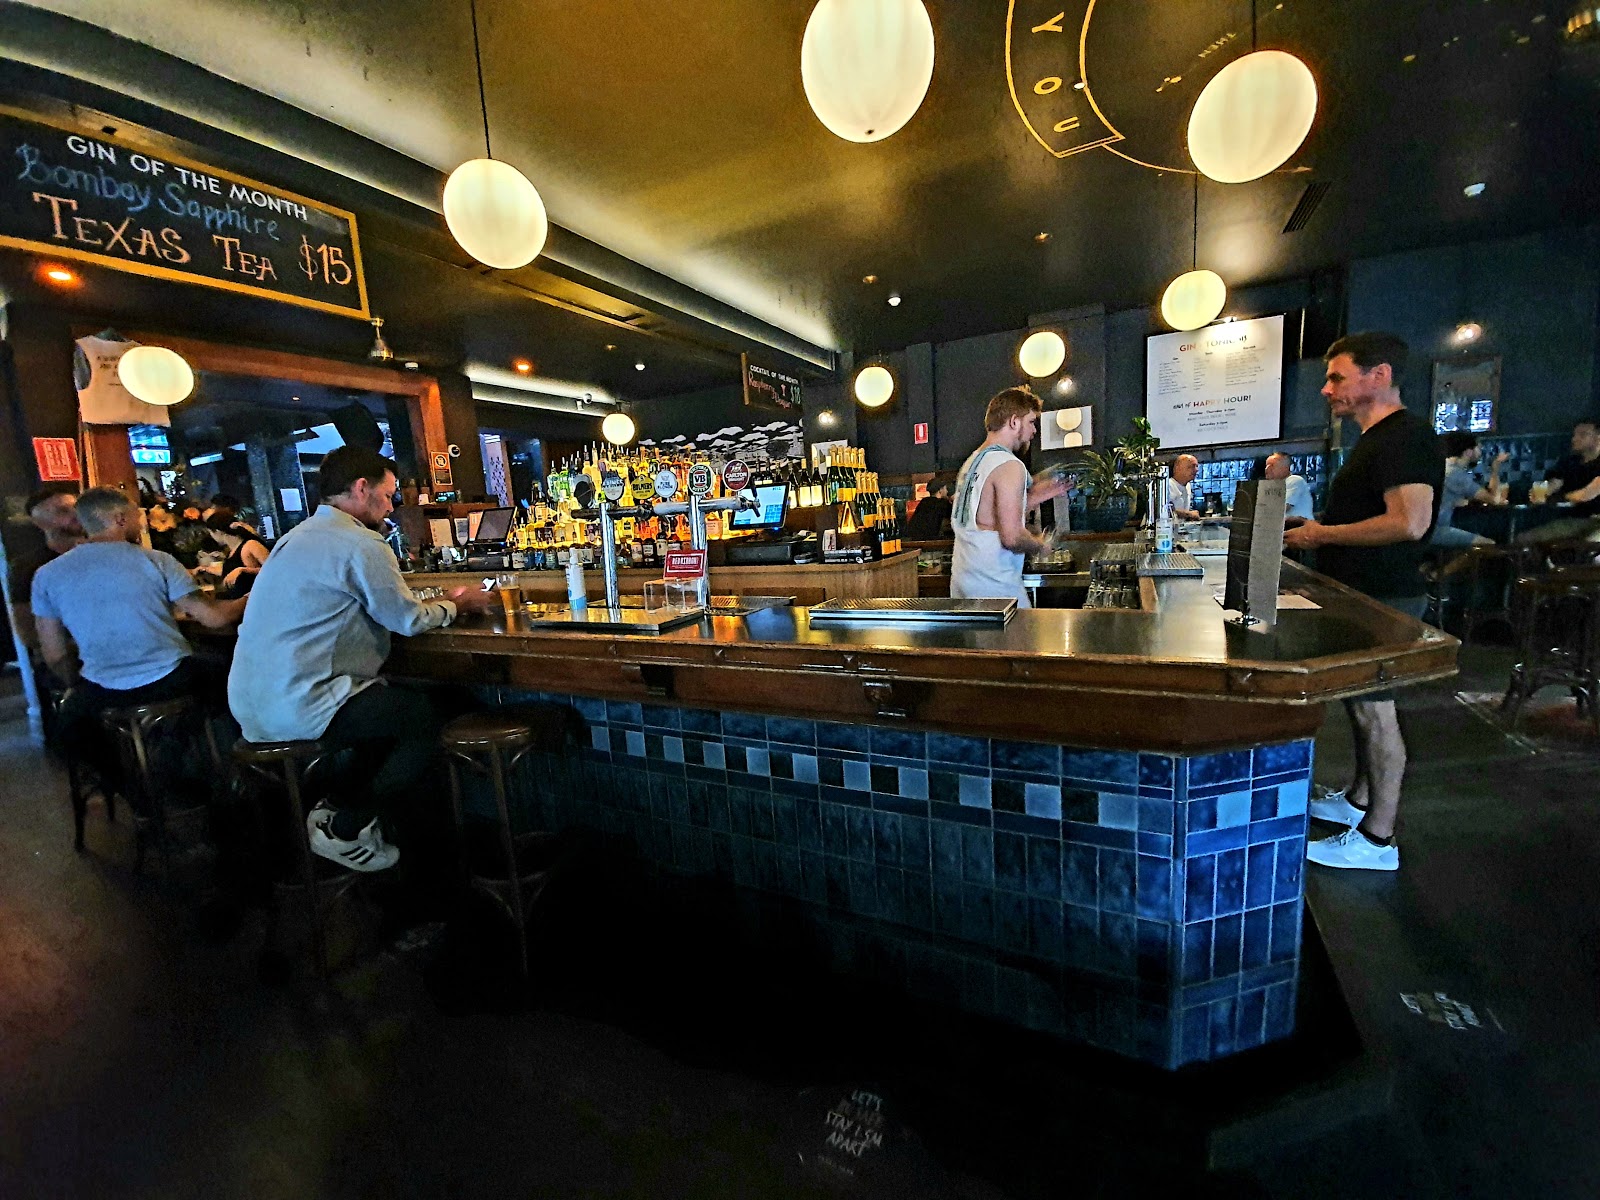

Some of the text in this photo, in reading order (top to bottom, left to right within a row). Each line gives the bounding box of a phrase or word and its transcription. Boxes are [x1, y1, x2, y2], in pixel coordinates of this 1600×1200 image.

[16, 142, 280, 241] Bombay Sapphire
[67, 136, 308, 221] GIN OF THE MONTH
[33, 192, 352, 286] TEXAS TEA $15
[1179, 343, 1197, 352] GIN
[1194, 399, 1220, 407] HAPPY
[1223, 395, 1251, 404] HOUR!
[694, 474, 706, 483] VB
